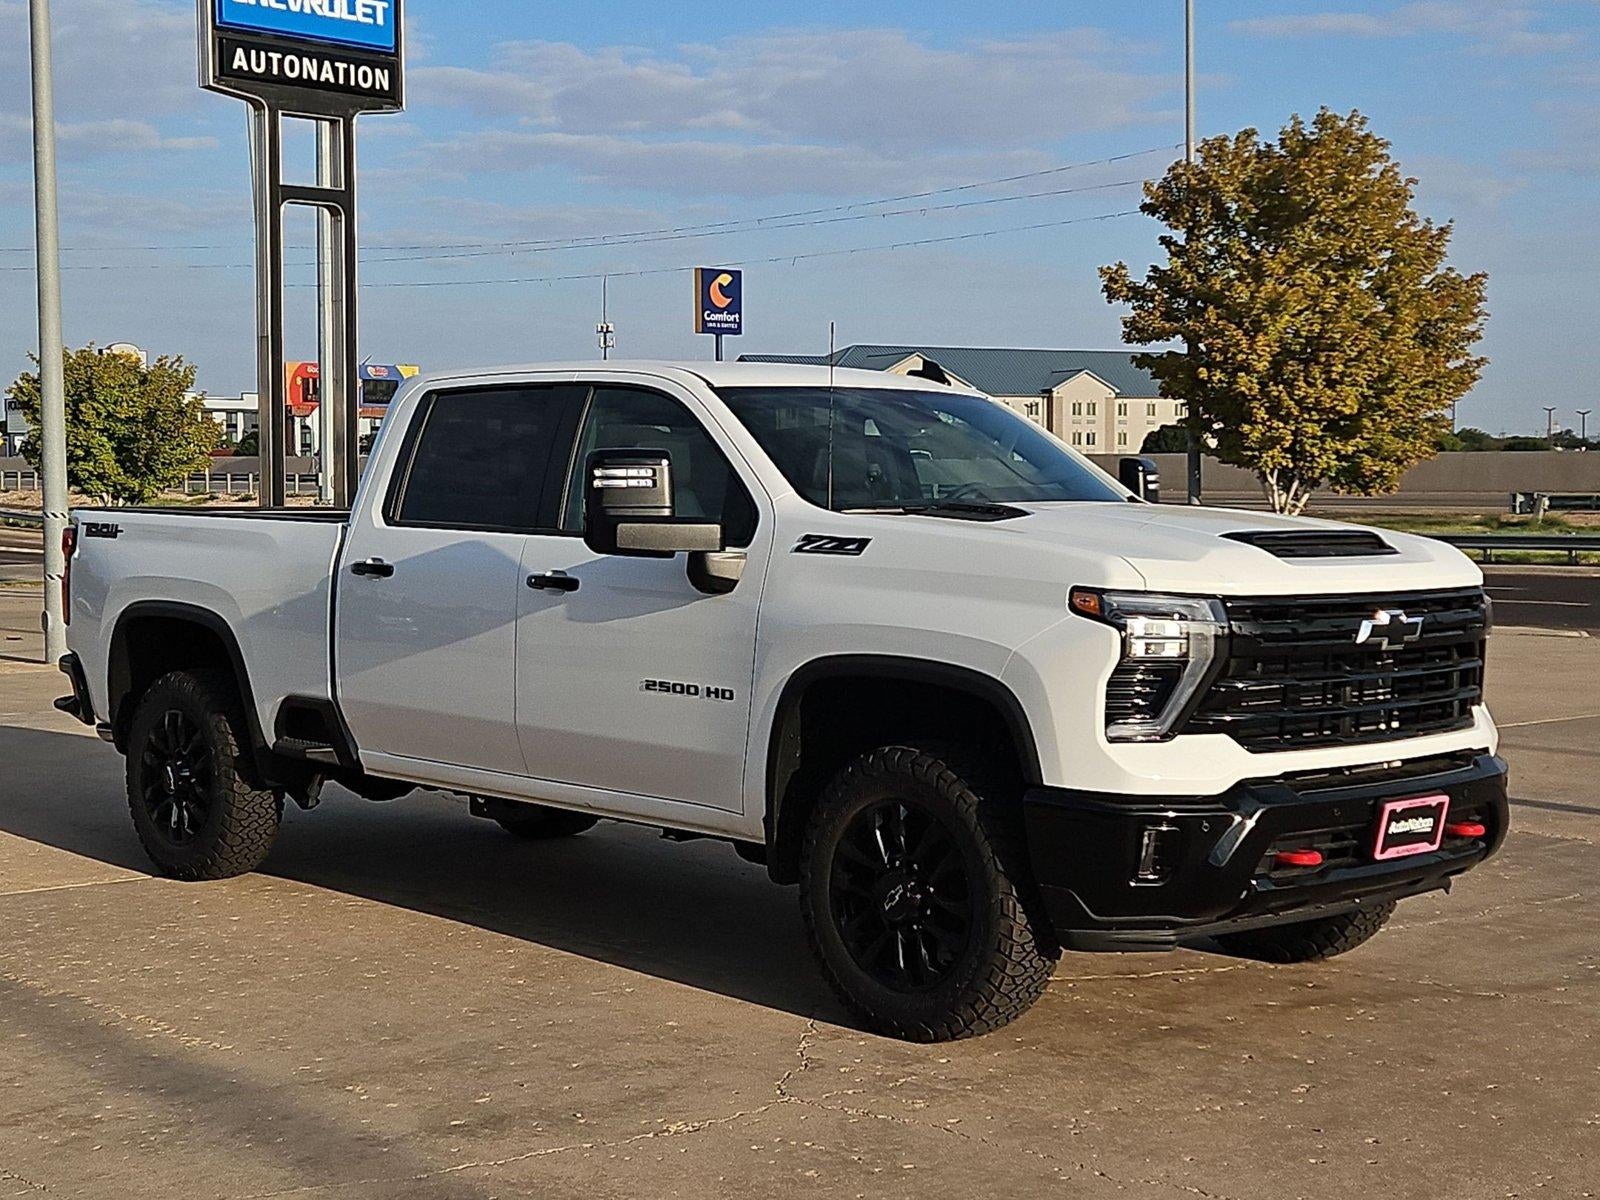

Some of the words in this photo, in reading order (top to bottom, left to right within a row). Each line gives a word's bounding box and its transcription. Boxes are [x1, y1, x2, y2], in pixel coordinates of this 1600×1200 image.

[231, 0, 389, 26] VROLET
[232, 47, 390, 91] AUTONATION
[704, 310, 740, 323] Comfort
[644, 679, 699, 697] 2500
[705, 685, 734, 701] HD
